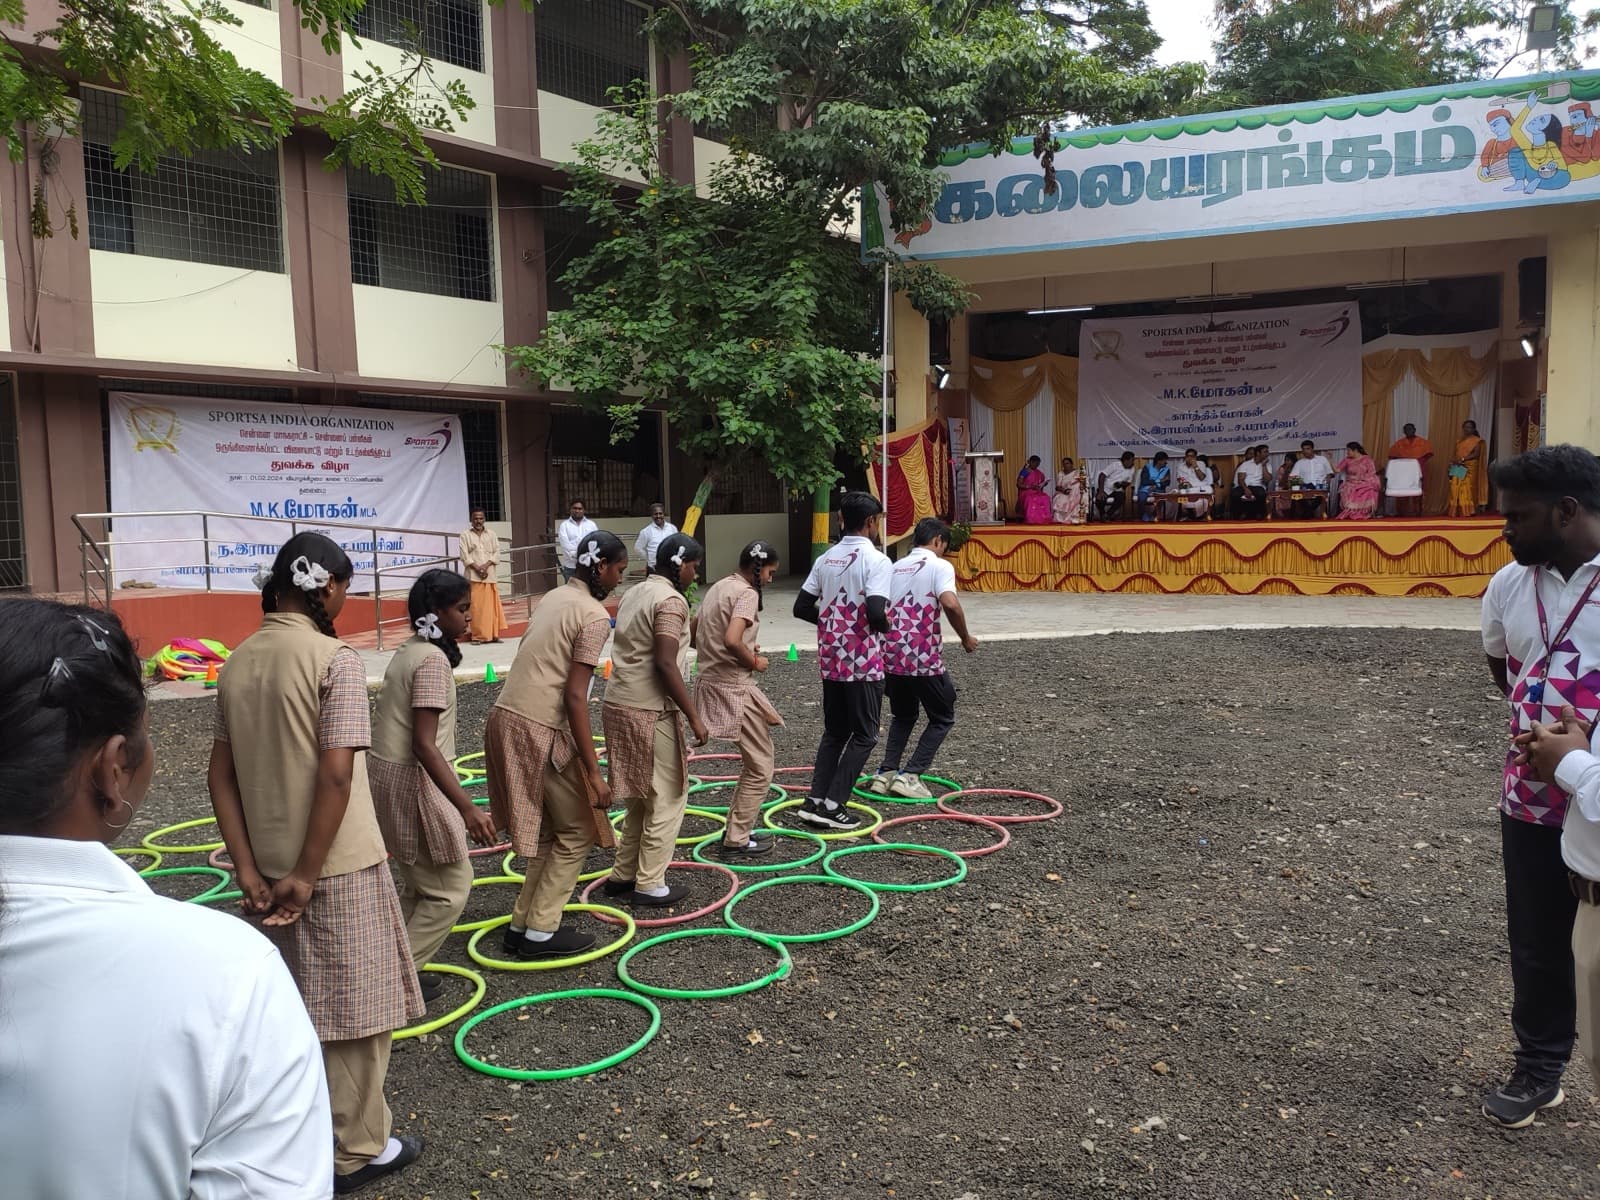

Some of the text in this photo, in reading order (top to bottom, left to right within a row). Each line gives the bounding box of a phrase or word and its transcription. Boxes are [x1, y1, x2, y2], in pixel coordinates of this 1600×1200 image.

[934, 105, 1478, 224] கலையரங்கம்
[1142, 319, 1290, 337] SPORTSA INDI GANIZATION
[1255, 386, 1273, 394] MLA
[208, 410, 394, 431] SPORTSA INDIA ORGANIZATION
[271, 459, 350, 473] துவக்க விழா
[360, 507, 377, 517] MLA
